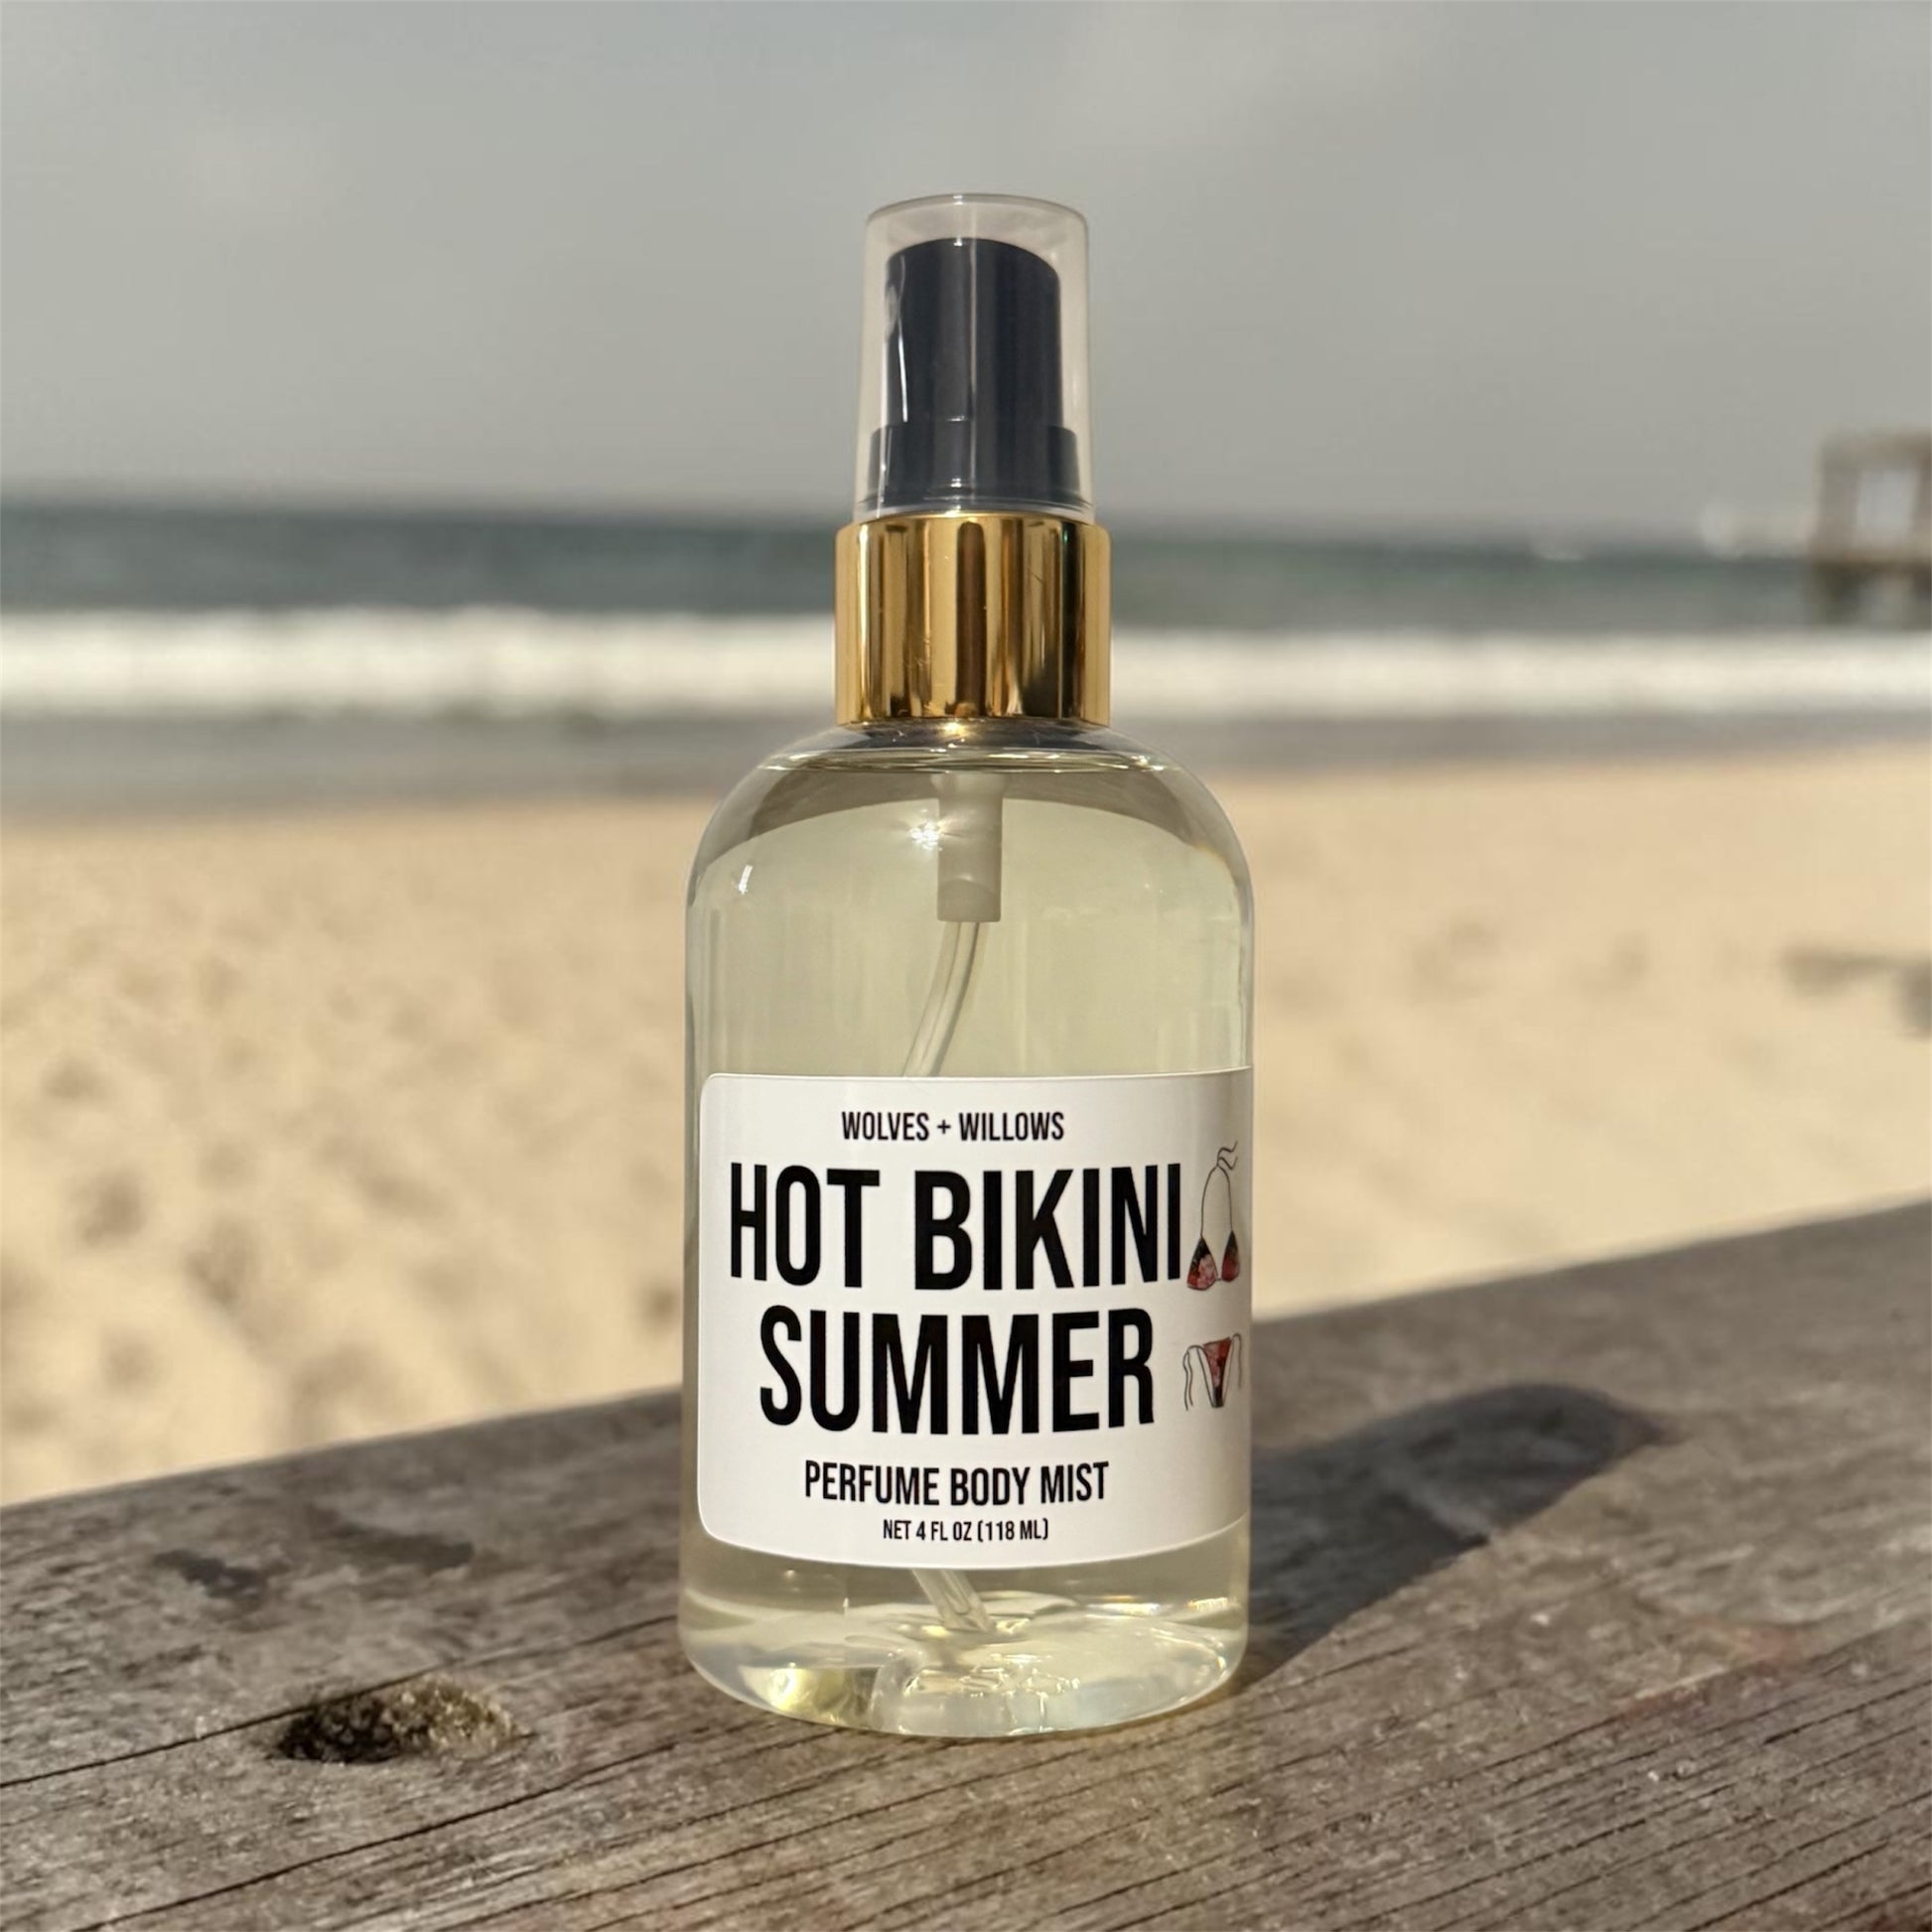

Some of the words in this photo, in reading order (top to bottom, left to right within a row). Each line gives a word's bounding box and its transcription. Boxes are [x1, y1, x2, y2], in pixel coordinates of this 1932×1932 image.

[842, 1111, 929, 1142] WOLVES
[958, 1111, 1064, 1142] WILLOWS
[730, 1162, 881, 1289] HOT
[914, 1163, 1181, 1291] BIKINI
[759, 1305, 1155, 1436] SUMMER
[805, 1459, 940, 1506] PERFUME
[950, 1464, 1031, 1507] BODY
[1040, 1460, 1110, 1504] MIST
[883, 1519, 911, 1541] NET
[915, 1521, 926, 1541] 4
[930, 1521, 948, 1541] FL
[952, 1521, 972, 1542] OZ
[977, 1520, 1016, 1543] (118
[1020, 1519, 1049, 1541] ML)
